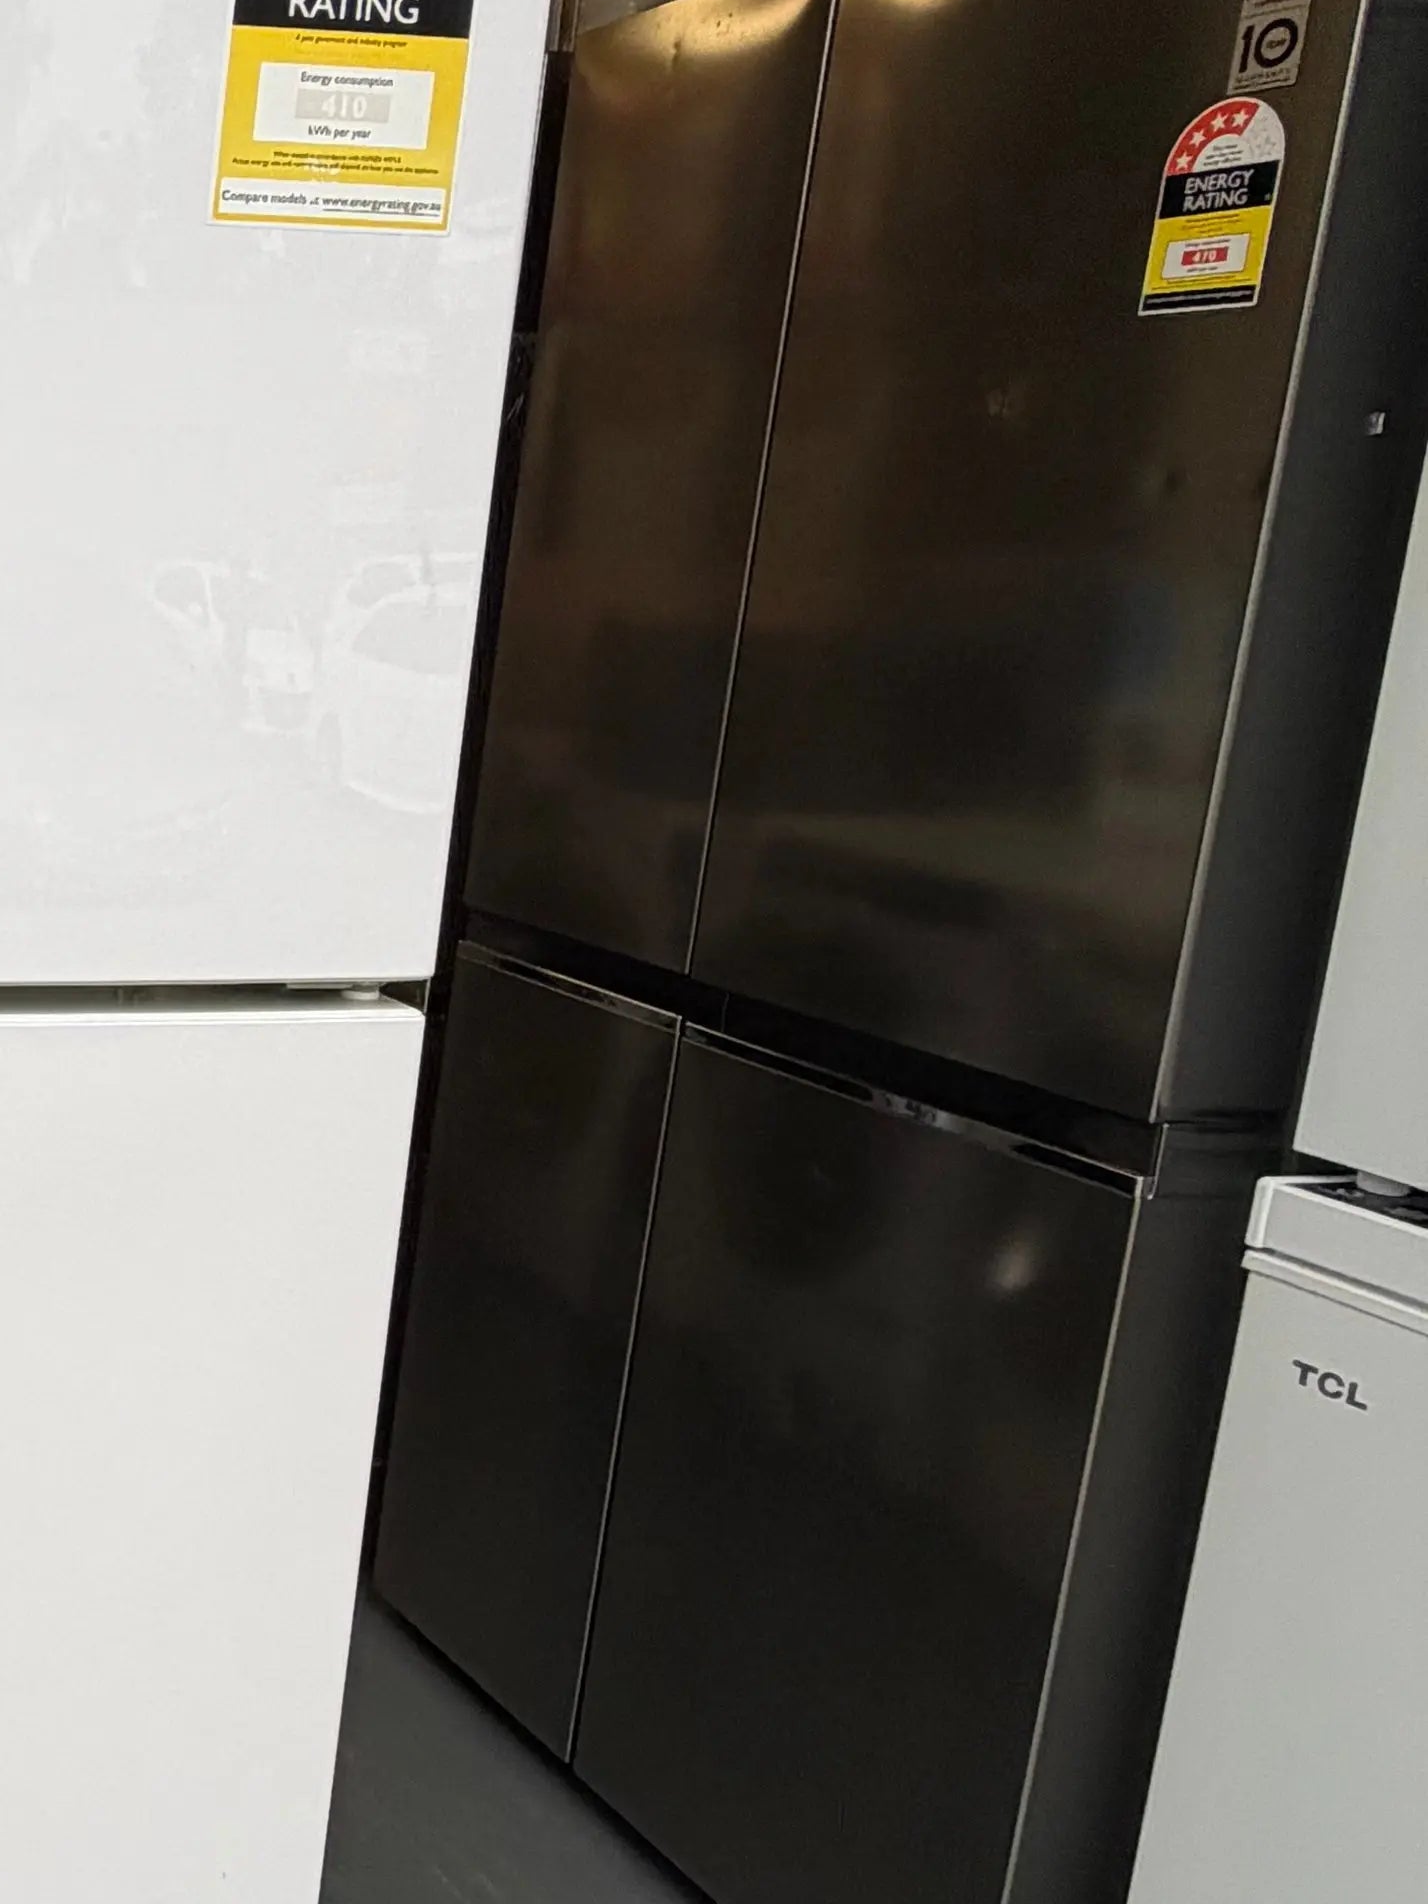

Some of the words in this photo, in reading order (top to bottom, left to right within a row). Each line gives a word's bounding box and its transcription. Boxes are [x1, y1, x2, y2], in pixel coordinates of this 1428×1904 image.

[1238, 17, 1298, 74] 10
[300, 71, 332, 86] Energy
[335, 75, 394, 87] consumption
[334, 128, 350, 139] per
[351, 129, 372, 141] year
[1184, 169, 1255, 195] ENERGY
[222, 189, 268, 204] Compare
[270, 192, 307, 205] models
[1183, 188, 1249, 212] RATING
[1292, 1358, 1368, 1412] TCL
